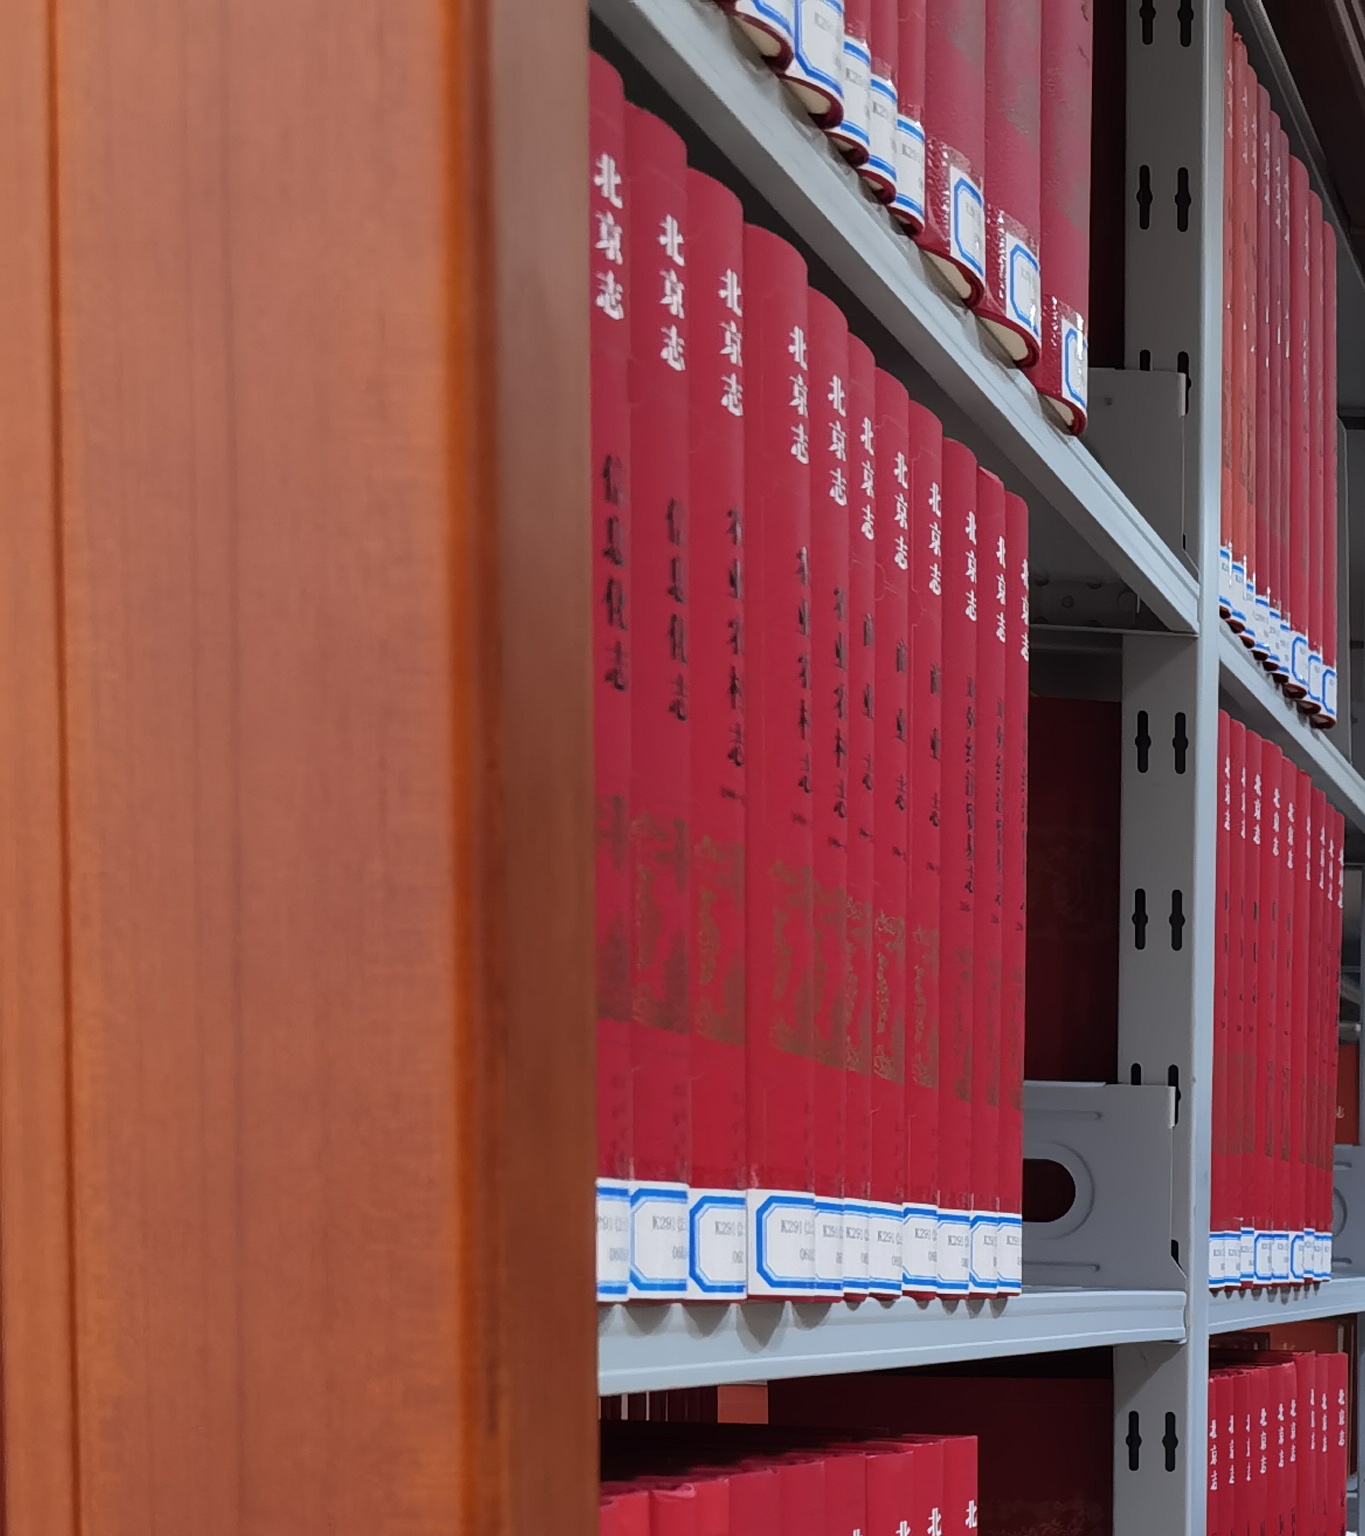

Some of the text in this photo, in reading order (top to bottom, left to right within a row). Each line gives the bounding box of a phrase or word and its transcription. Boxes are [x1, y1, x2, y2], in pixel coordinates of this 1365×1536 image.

[593, 153, 624, 321] 北京志
[658, 214, 686, 372] 北京志
[717, 268, 743, 417] 北京志
[788, 325, 809, 465] 北京志
[827, 374, 848, 507] 北京志
[859, 416, 875, 541] 北京志
[893, 451, 909, 570] 北京志
